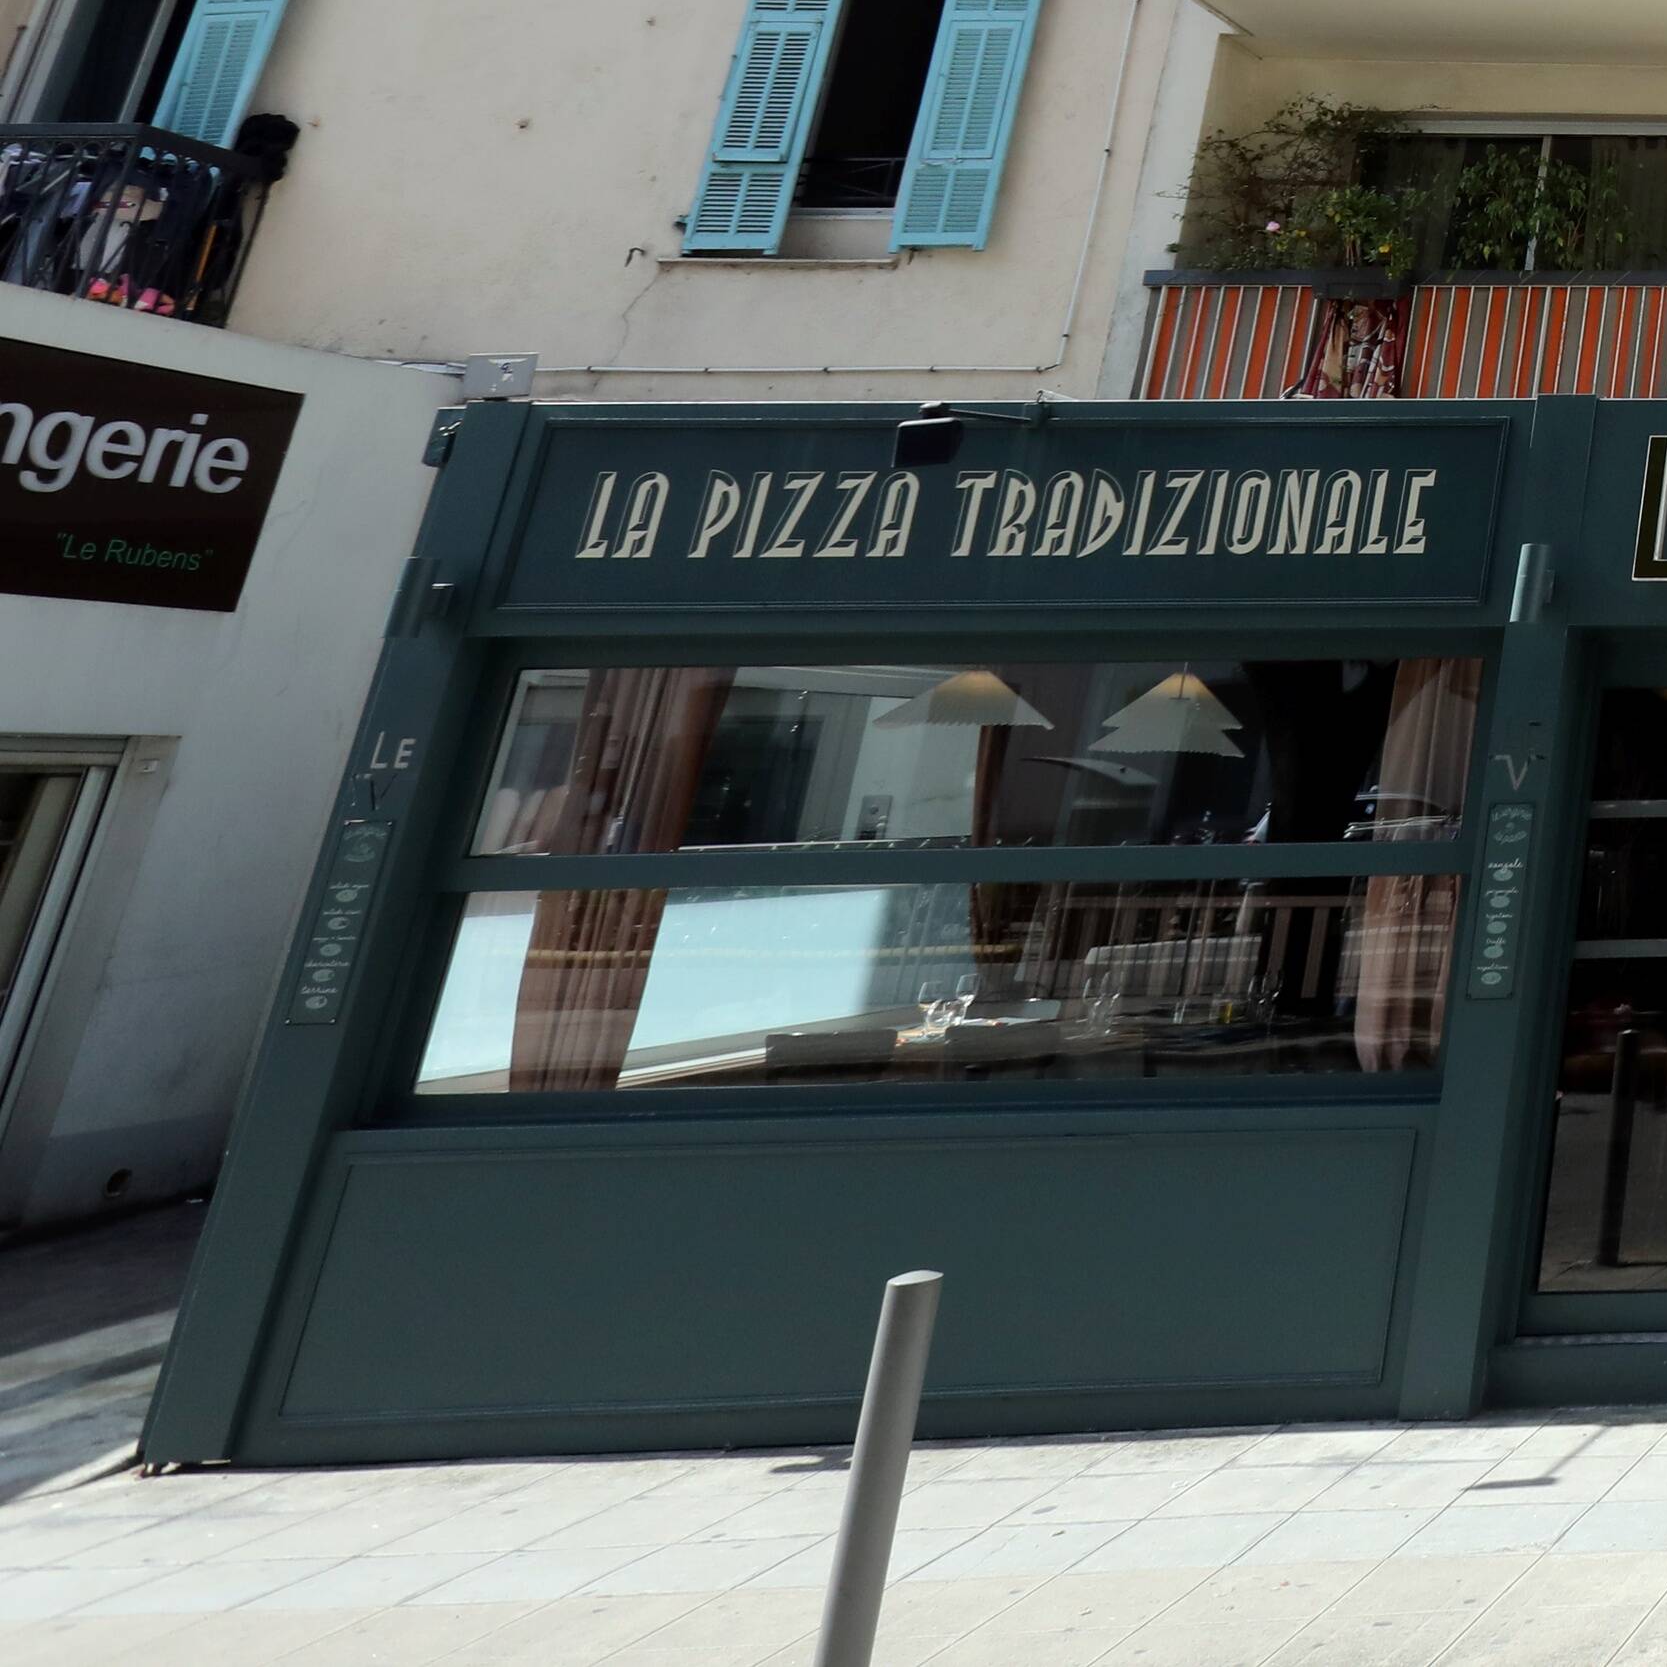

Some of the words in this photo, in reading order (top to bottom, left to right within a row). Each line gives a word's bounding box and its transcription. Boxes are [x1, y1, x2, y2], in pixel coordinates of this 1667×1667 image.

[576, 471, 668, 560] LA
[687, 469, 919, 560] PIZZA
[950, 468, 1437, 559] TRADIZIONALE
